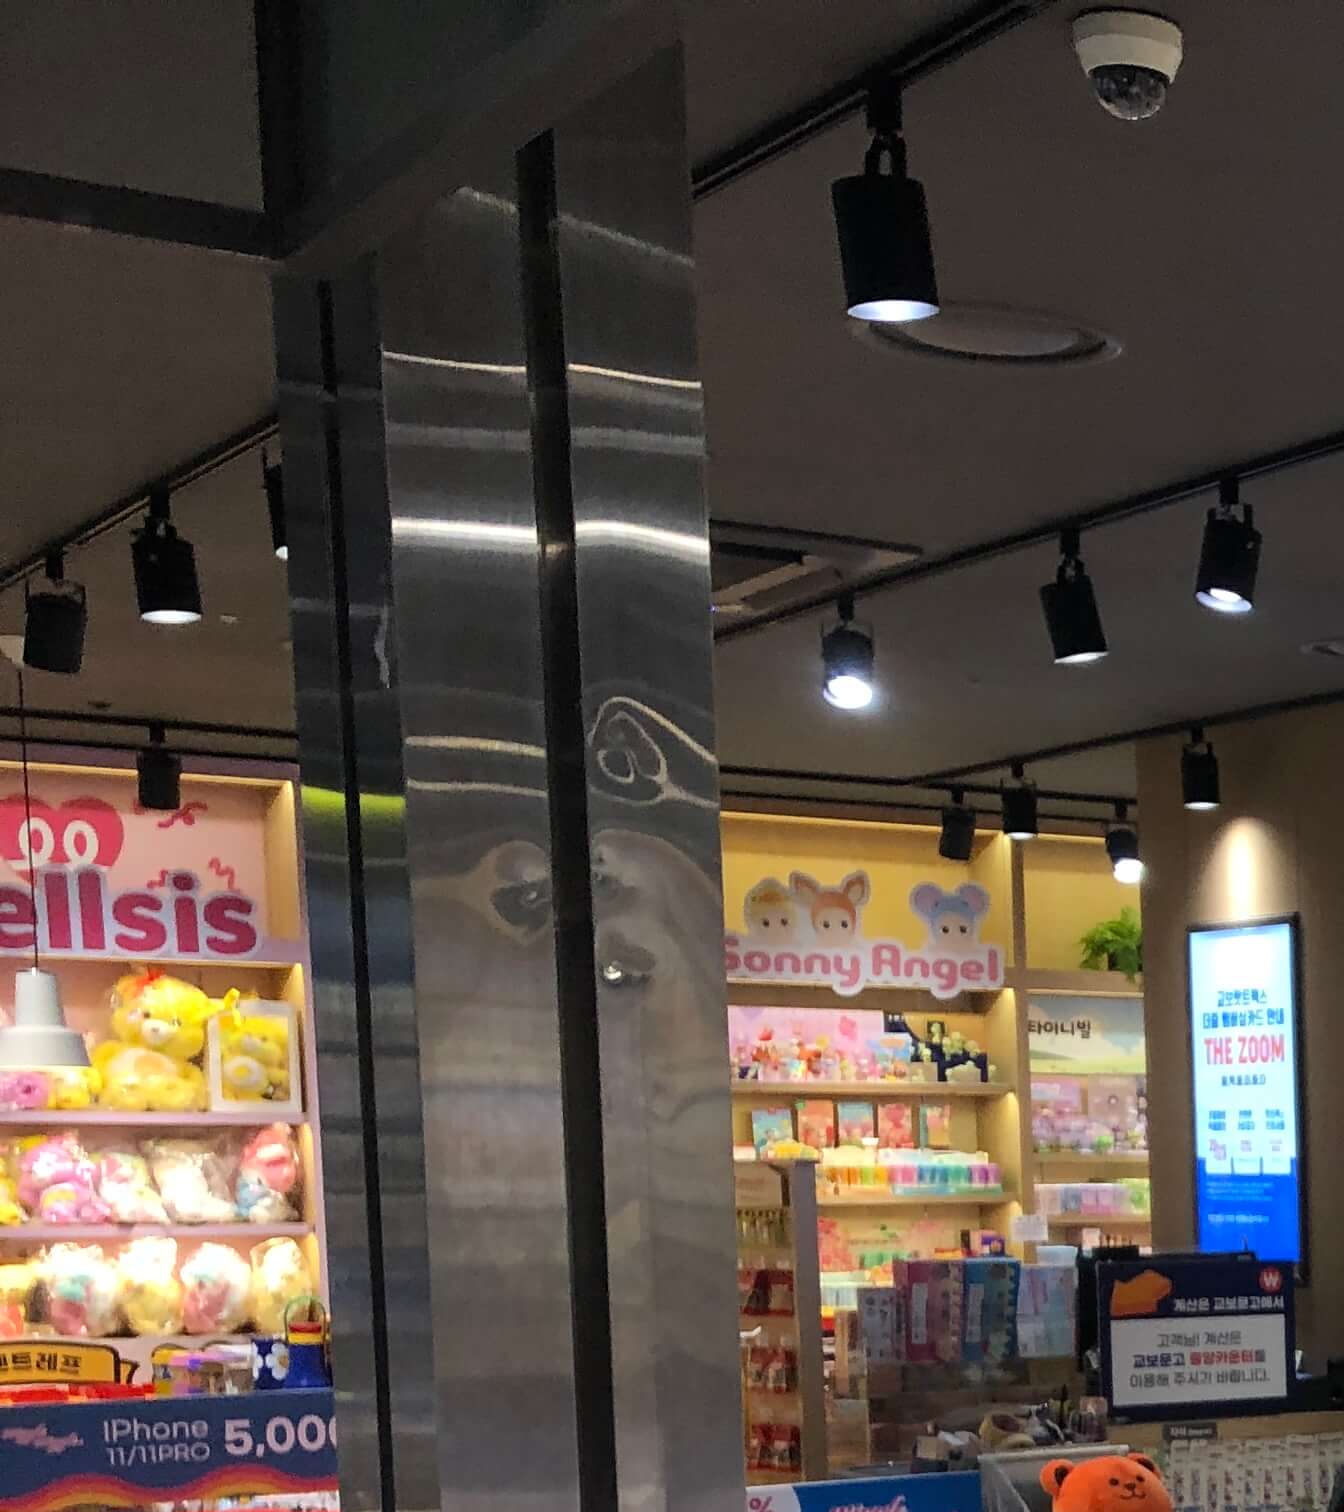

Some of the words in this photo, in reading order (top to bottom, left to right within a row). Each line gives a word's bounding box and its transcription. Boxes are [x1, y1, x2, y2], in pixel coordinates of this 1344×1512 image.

[872, 943, 1000, 989] Angel
[1203, 1036, 1233, 1065] THE
[1238, 1033, 1285, 1064] ZOOM
[1204, 1330, 1242, 1346] 계산은
[1133, 1352, 1186, 1369] 교보문고
[1173, 1369, 1213, 1387] 주시기
[223, 1414, 337, 1458] 5,00
[105, 1442, 211, 1467] 11/11PRO
